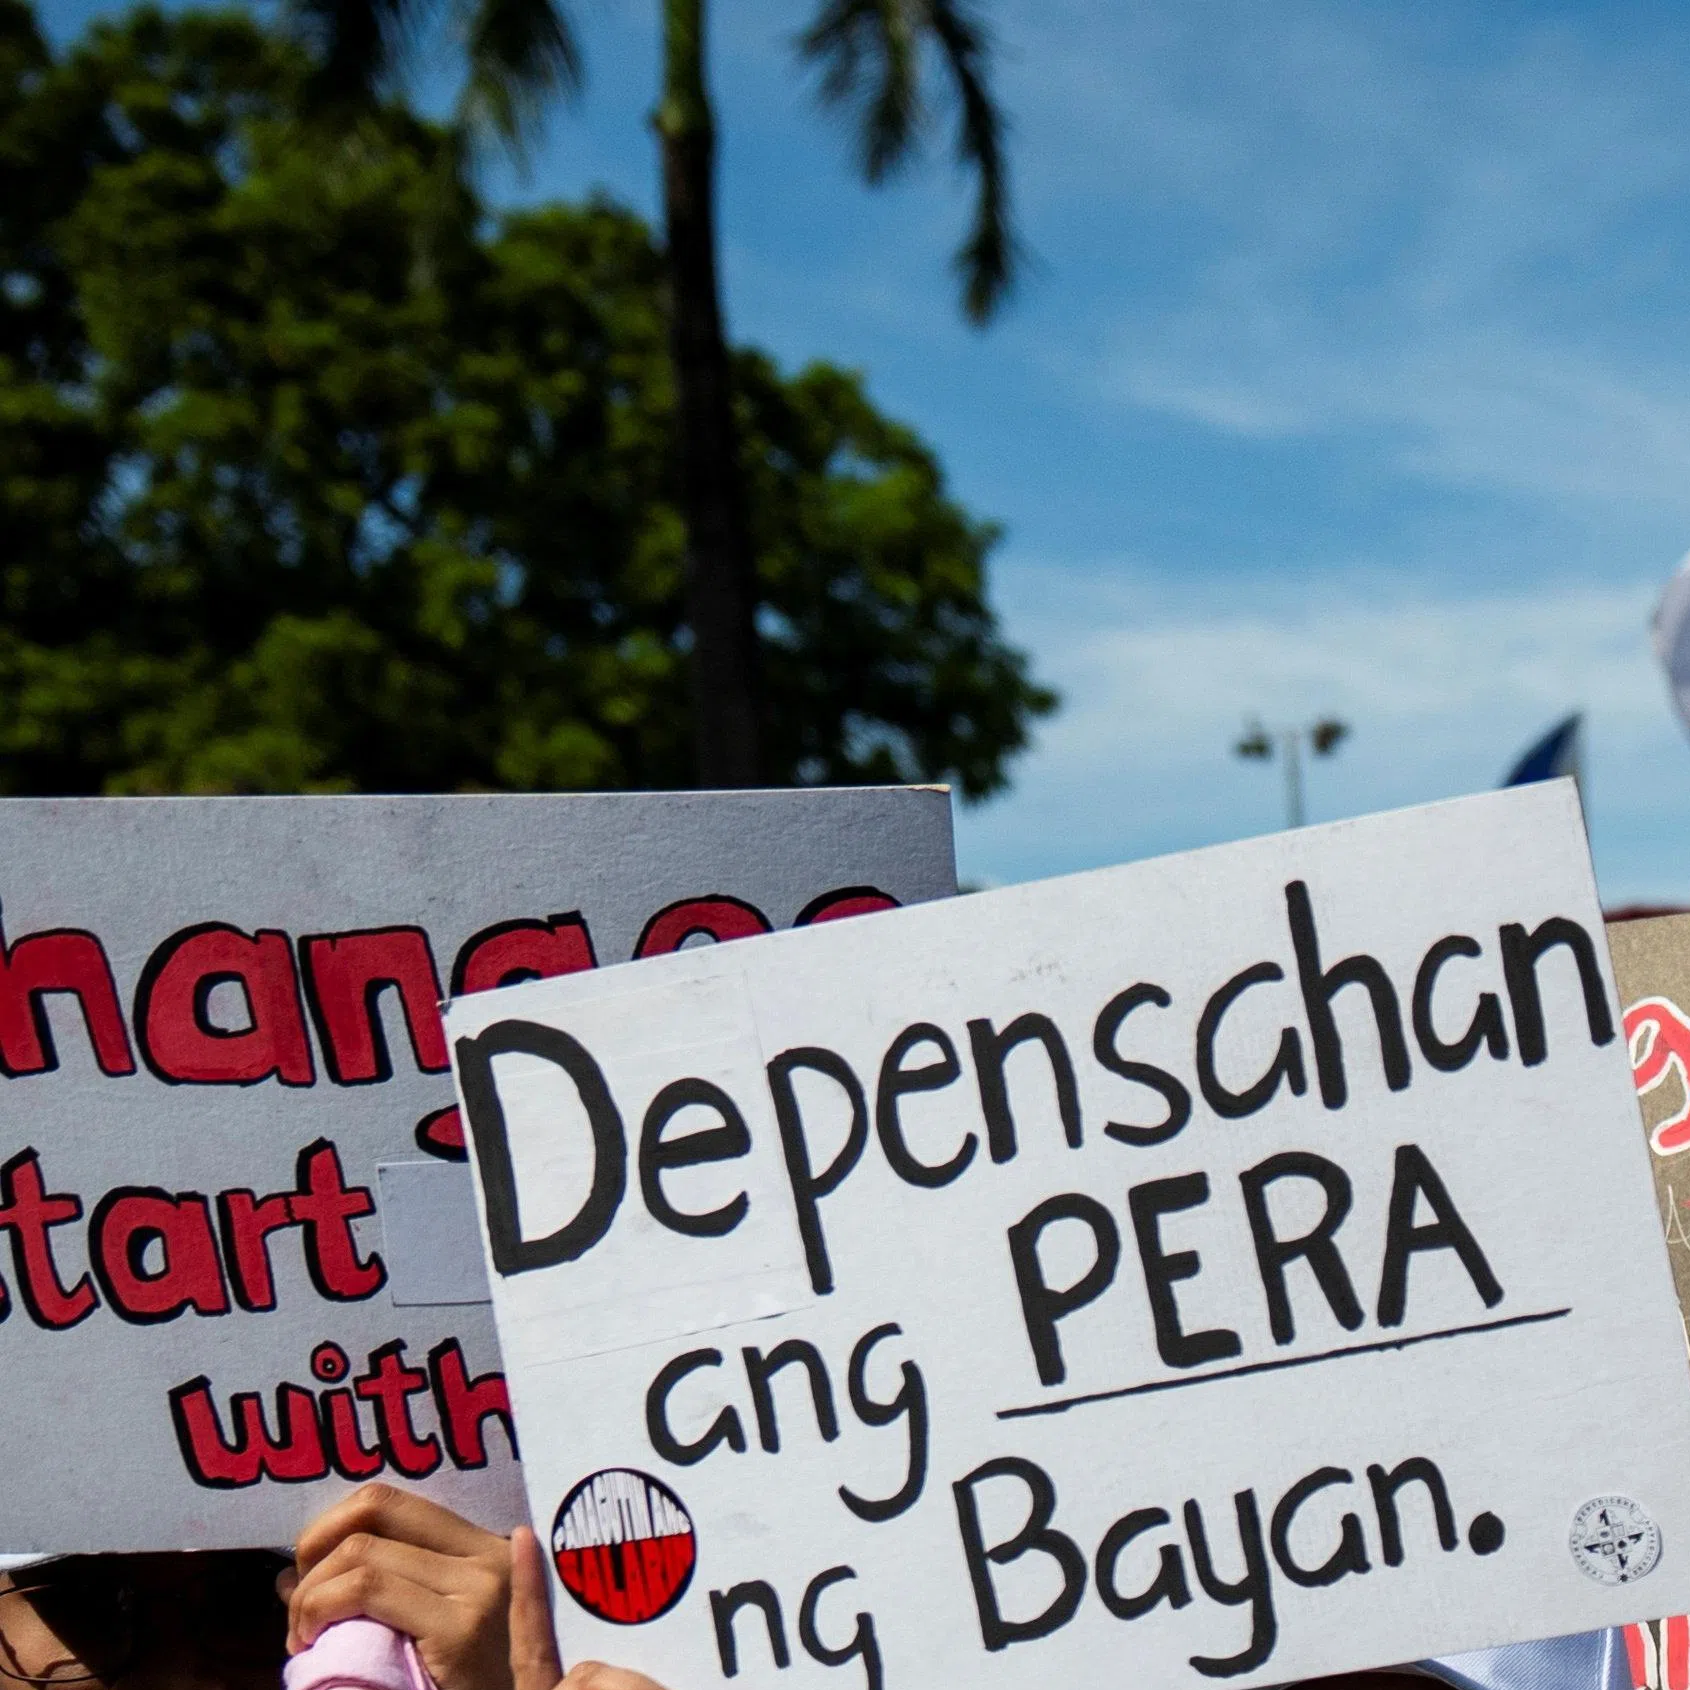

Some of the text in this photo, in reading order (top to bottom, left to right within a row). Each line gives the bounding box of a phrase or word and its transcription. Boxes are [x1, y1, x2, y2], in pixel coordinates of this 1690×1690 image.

[0, 1136, 389, 1330] tart
[644, 1144, 1504, 1521] ang PERA
[169, 1337, 519, 1489] with
[953, 1455, 1507, 1679] Bayan.
